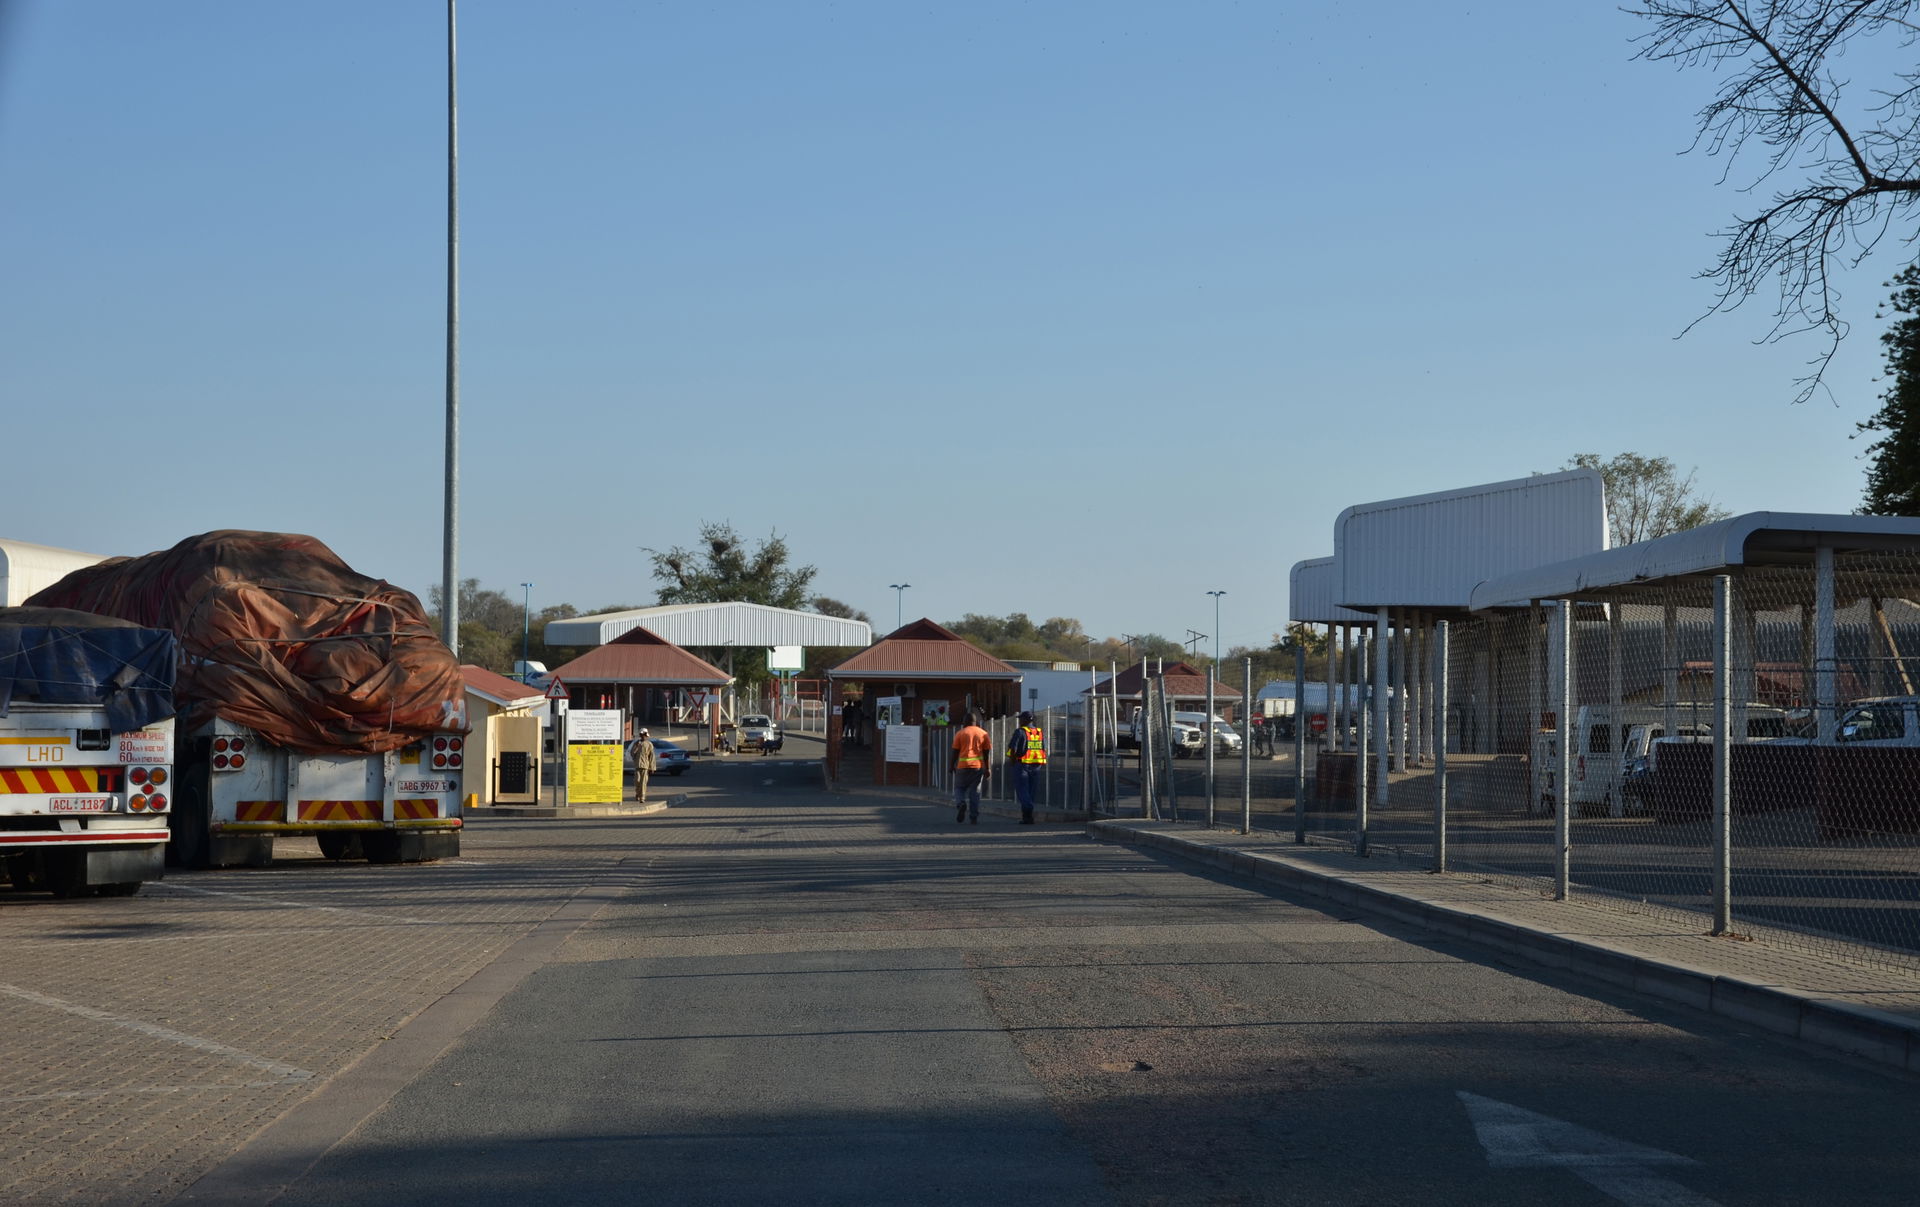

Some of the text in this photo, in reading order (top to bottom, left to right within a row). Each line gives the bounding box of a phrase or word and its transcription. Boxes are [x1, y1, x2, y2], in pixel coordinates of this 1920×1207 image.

[1028, 741, 1043, 749] POLICE
[420, 781, 439, 791] 9967
[53, 799, 72, 810] ACL
